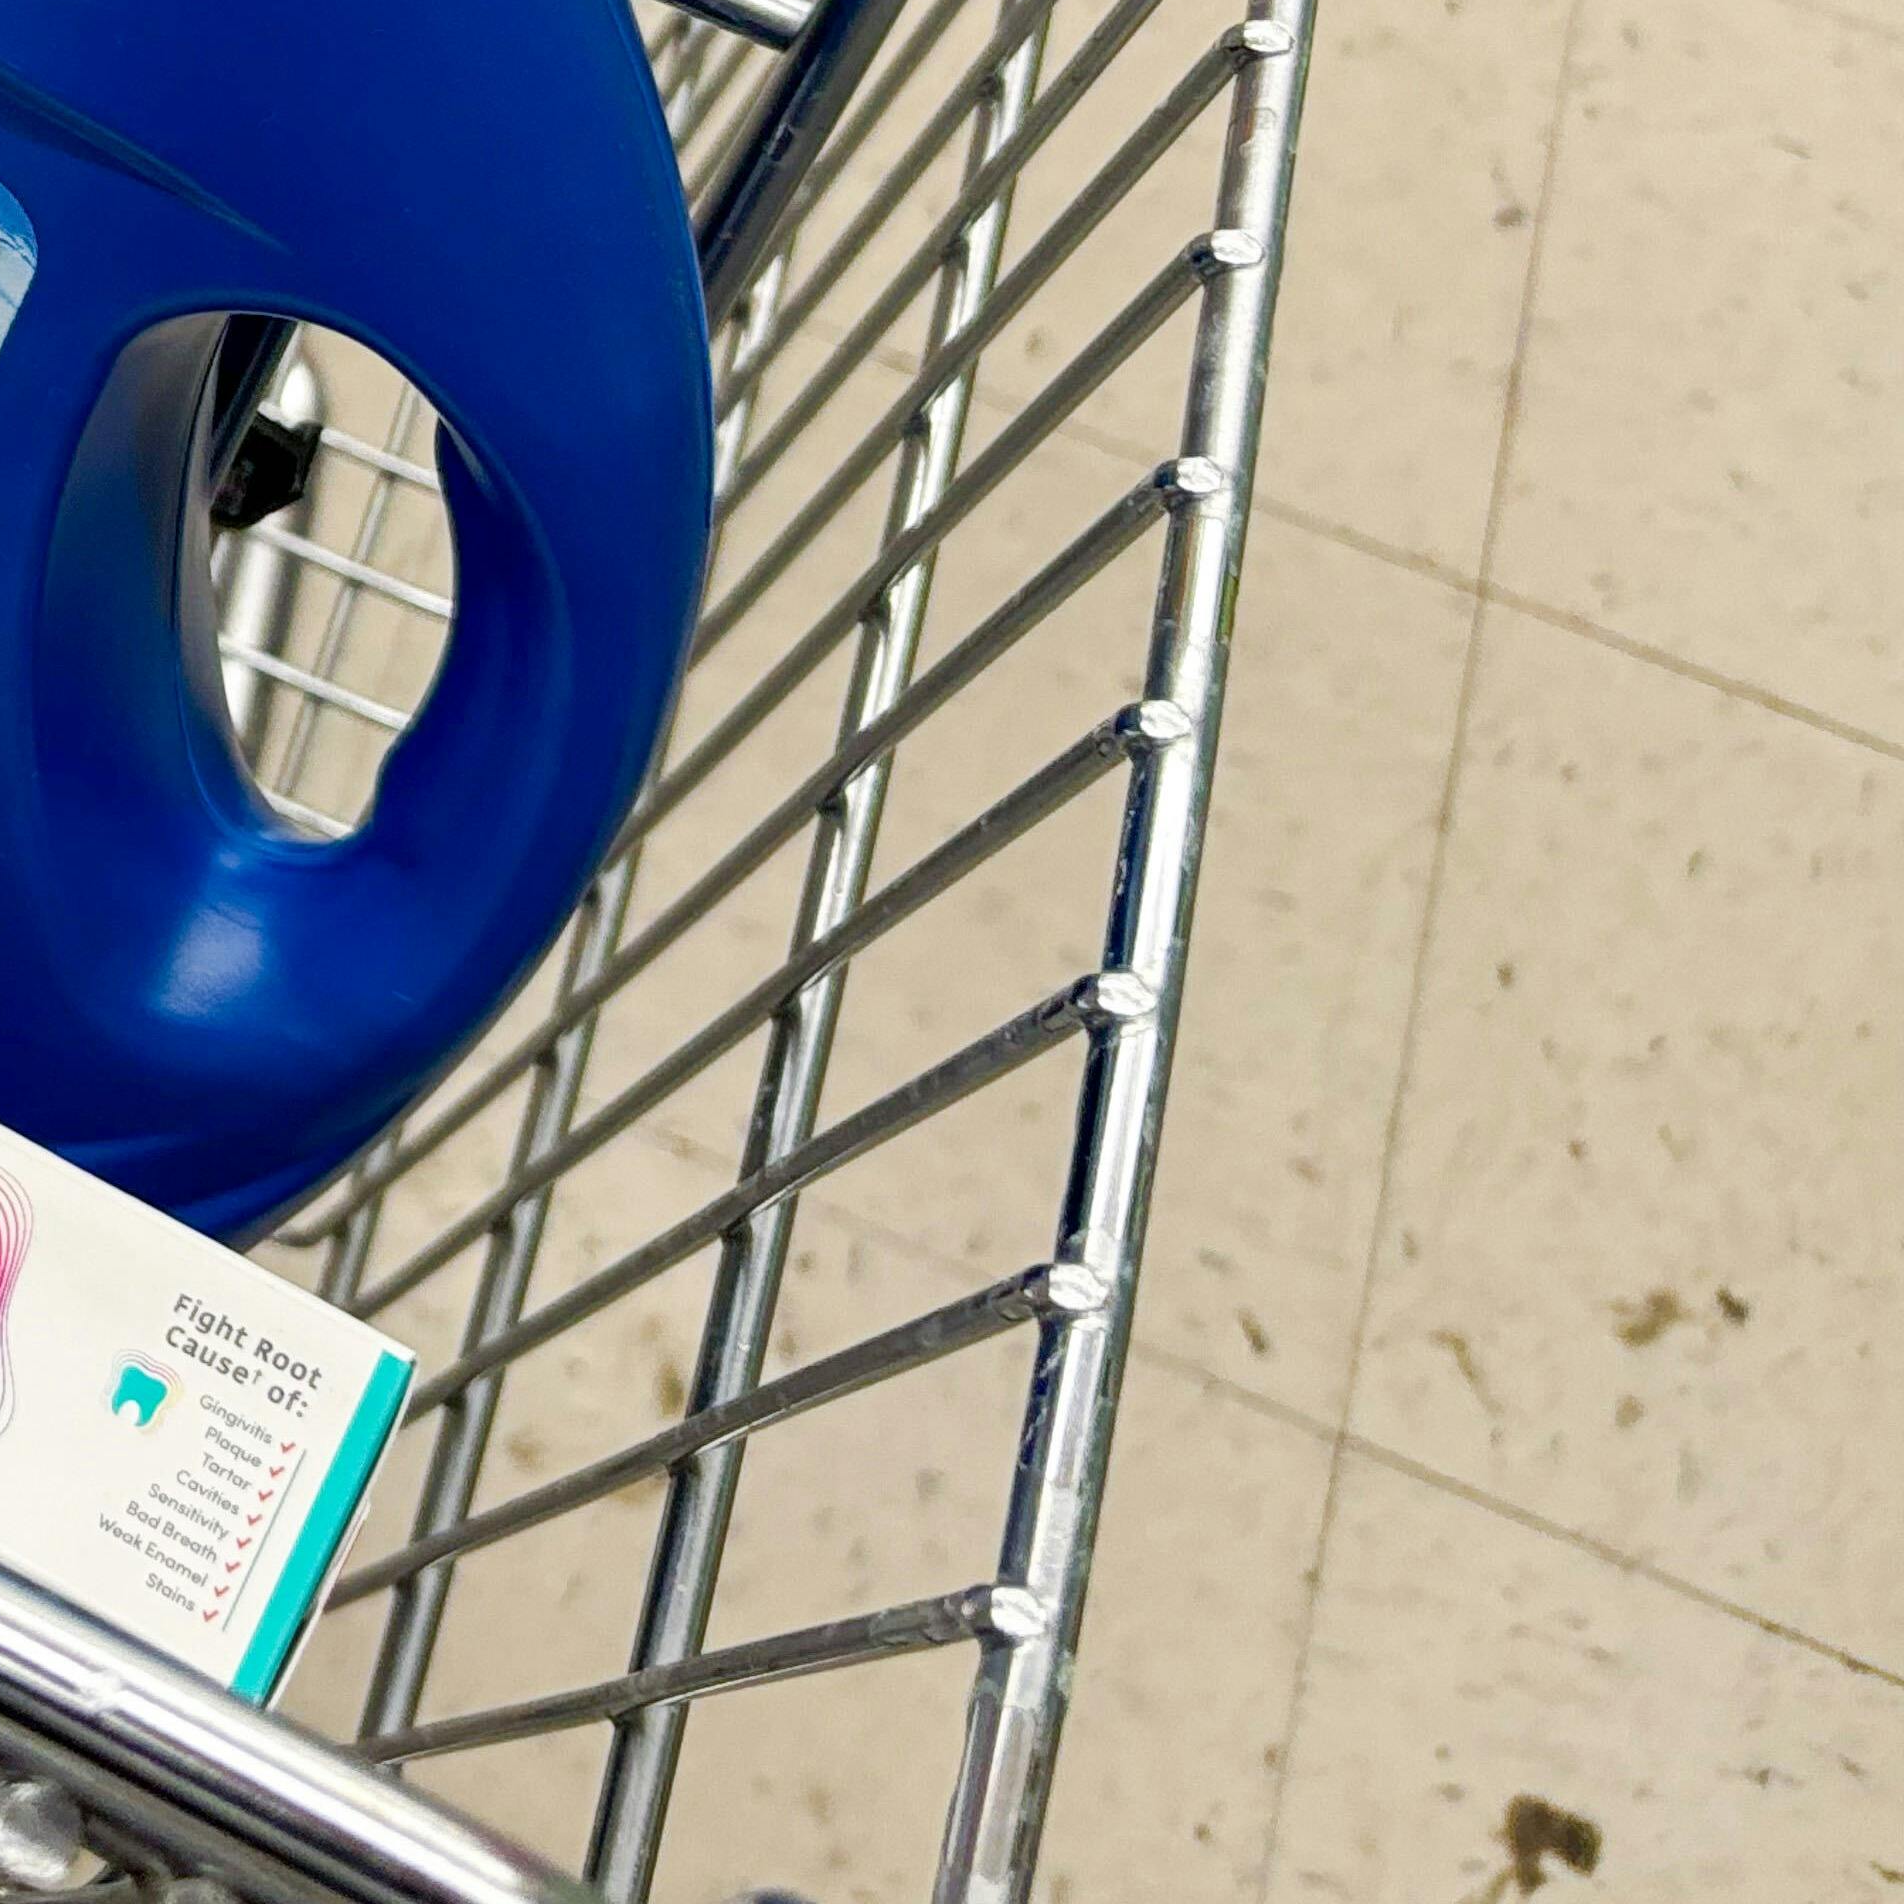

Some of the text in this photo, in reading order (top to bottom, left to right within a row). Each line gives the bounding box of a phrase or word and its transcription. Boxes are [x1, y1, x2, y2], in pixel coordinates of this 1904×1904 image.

[173, 1293, 323, 1390] Fight Root
[200, 1394, 273, 1445] Gingivitis
[267, 1385, 309, 1418] of:
[205, 1426, 262, 1467] Plaque
[176, 1470, 241, 1516] Cavities
[203, 1452, 253, 1491] Tartar
[125, 1500, 218, 1564] Bad Breath
[148, 1483, 229, 1540] Sensitivity
[99, 1513, 209, 1588] Weak Enamel
[145, 1573, 195, 1612] Stains
